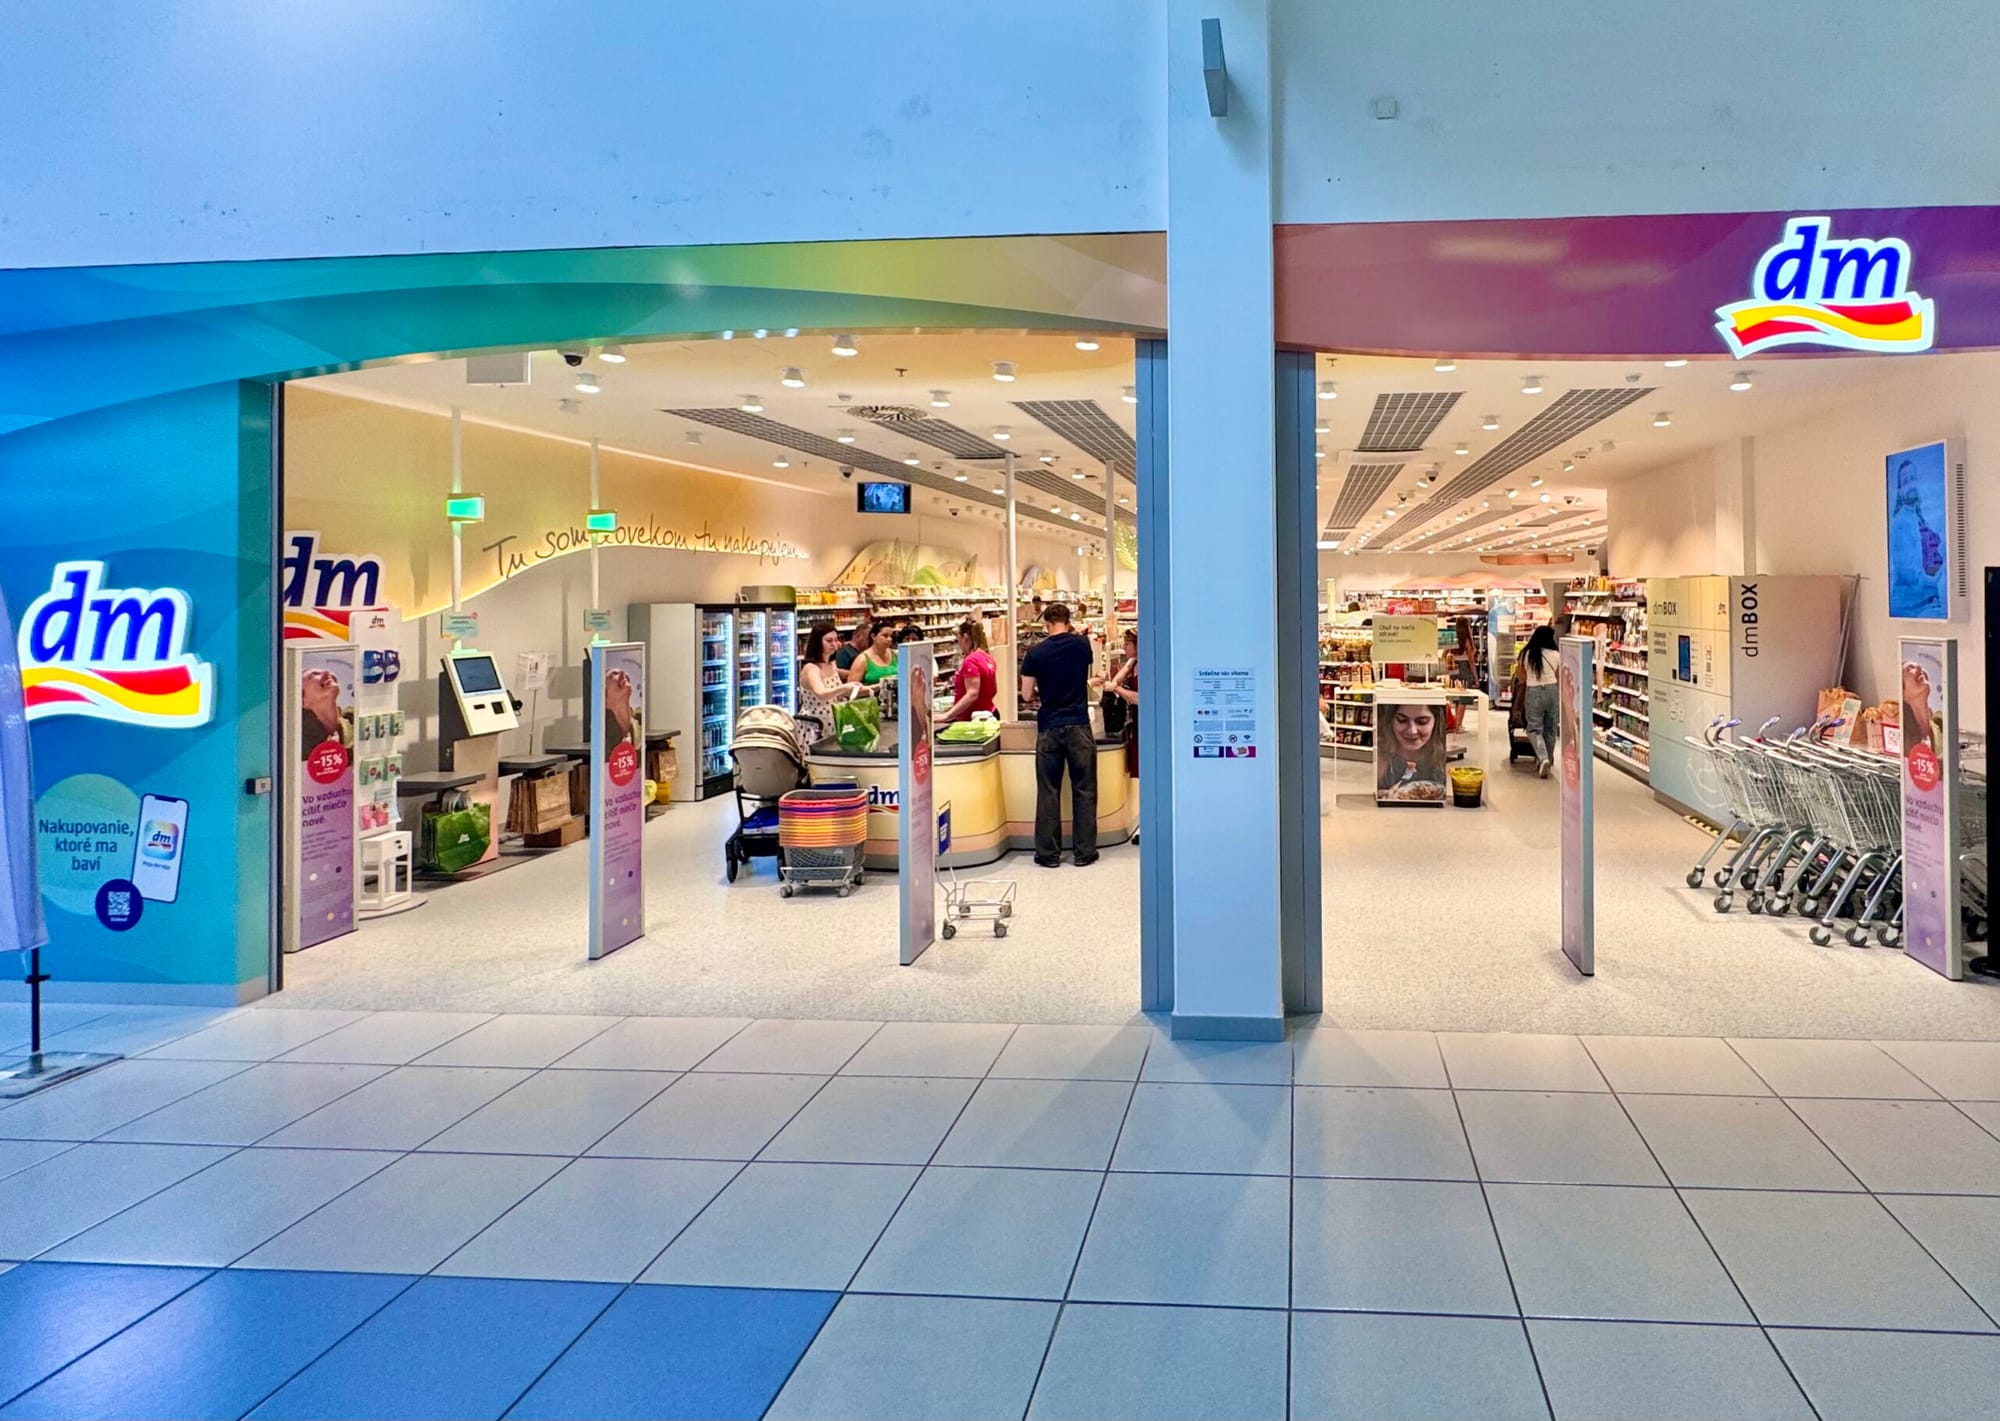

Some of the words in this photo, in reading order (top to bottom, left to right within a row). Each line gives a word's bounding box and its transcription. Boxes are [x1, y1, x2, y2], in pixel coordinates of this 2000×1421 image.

[1764, 224, 1900, 301] dm
[482, 535, 528, 580] Tu
[535, 526, 589, 559] som
[597, 513, 697, 555] ovekom,
[283, 536, 380, 607] dm
[30, 569, 176, 664] dm
[1653, 601, 1677, 616] dmBOX
[371, 615, 384, 625] dm
[1741, 583, 1759, 658] dmBOX
[313, 753, 343, 768] -15%
[612, 754, 634, 769] -15%
[1912, 758, 1935, 775] -15%
[302, 795, 315, 804] Vo
[868, 785, 900, 805] dm
[39, 819, 134, 837] Nakupovanie,
[55, 837, 91, 853] ktoré
[95, 841, 118, 853] ma
[152, 831, 171, 843] dm
[72, 855, 102, 871] baví
